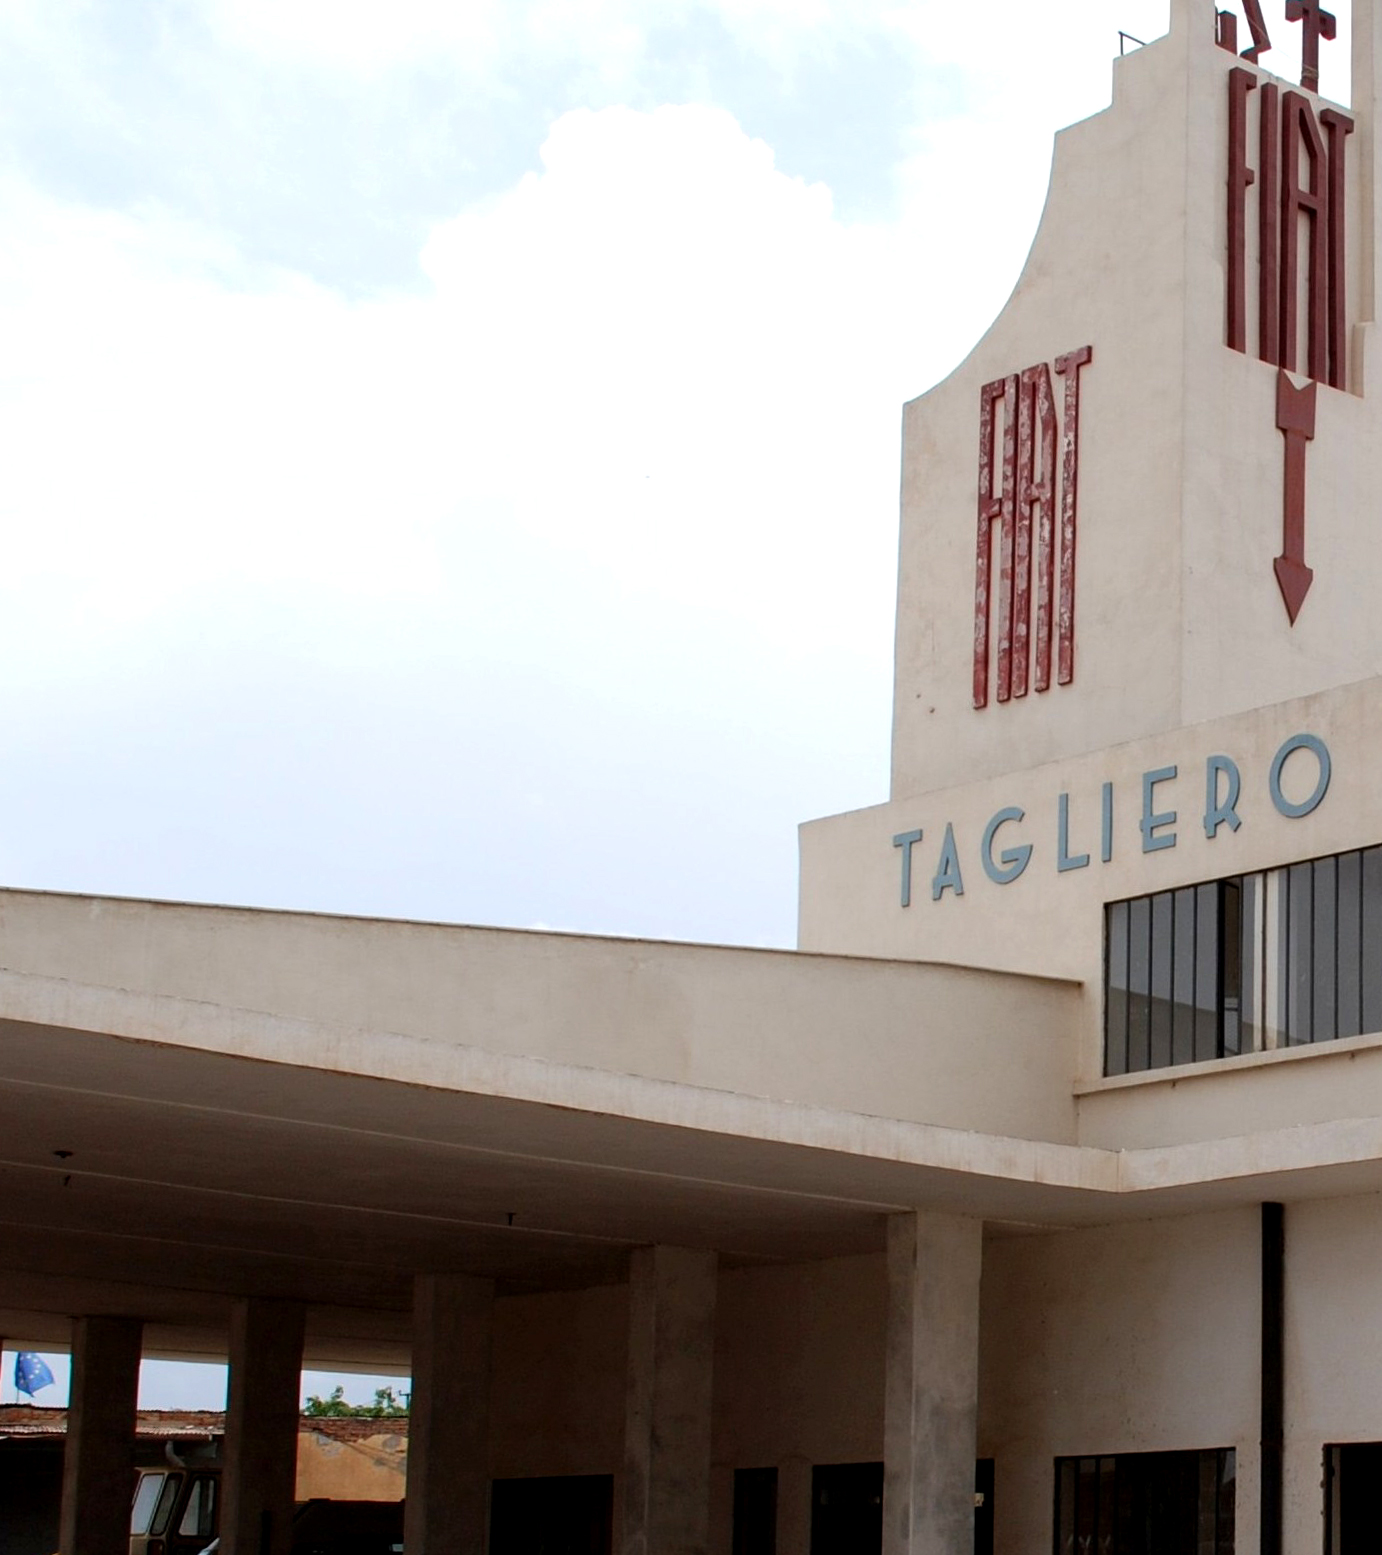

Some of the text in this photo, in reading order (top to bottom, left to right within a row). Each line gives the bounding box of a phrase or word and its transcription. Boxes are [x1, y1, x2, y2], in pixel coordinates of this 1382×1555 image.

[1227, 66, 1354, 391] FIAT
[972, 345, 1092, 709] FIAT
[893, 733, 1331, 908] TAGLIERO
